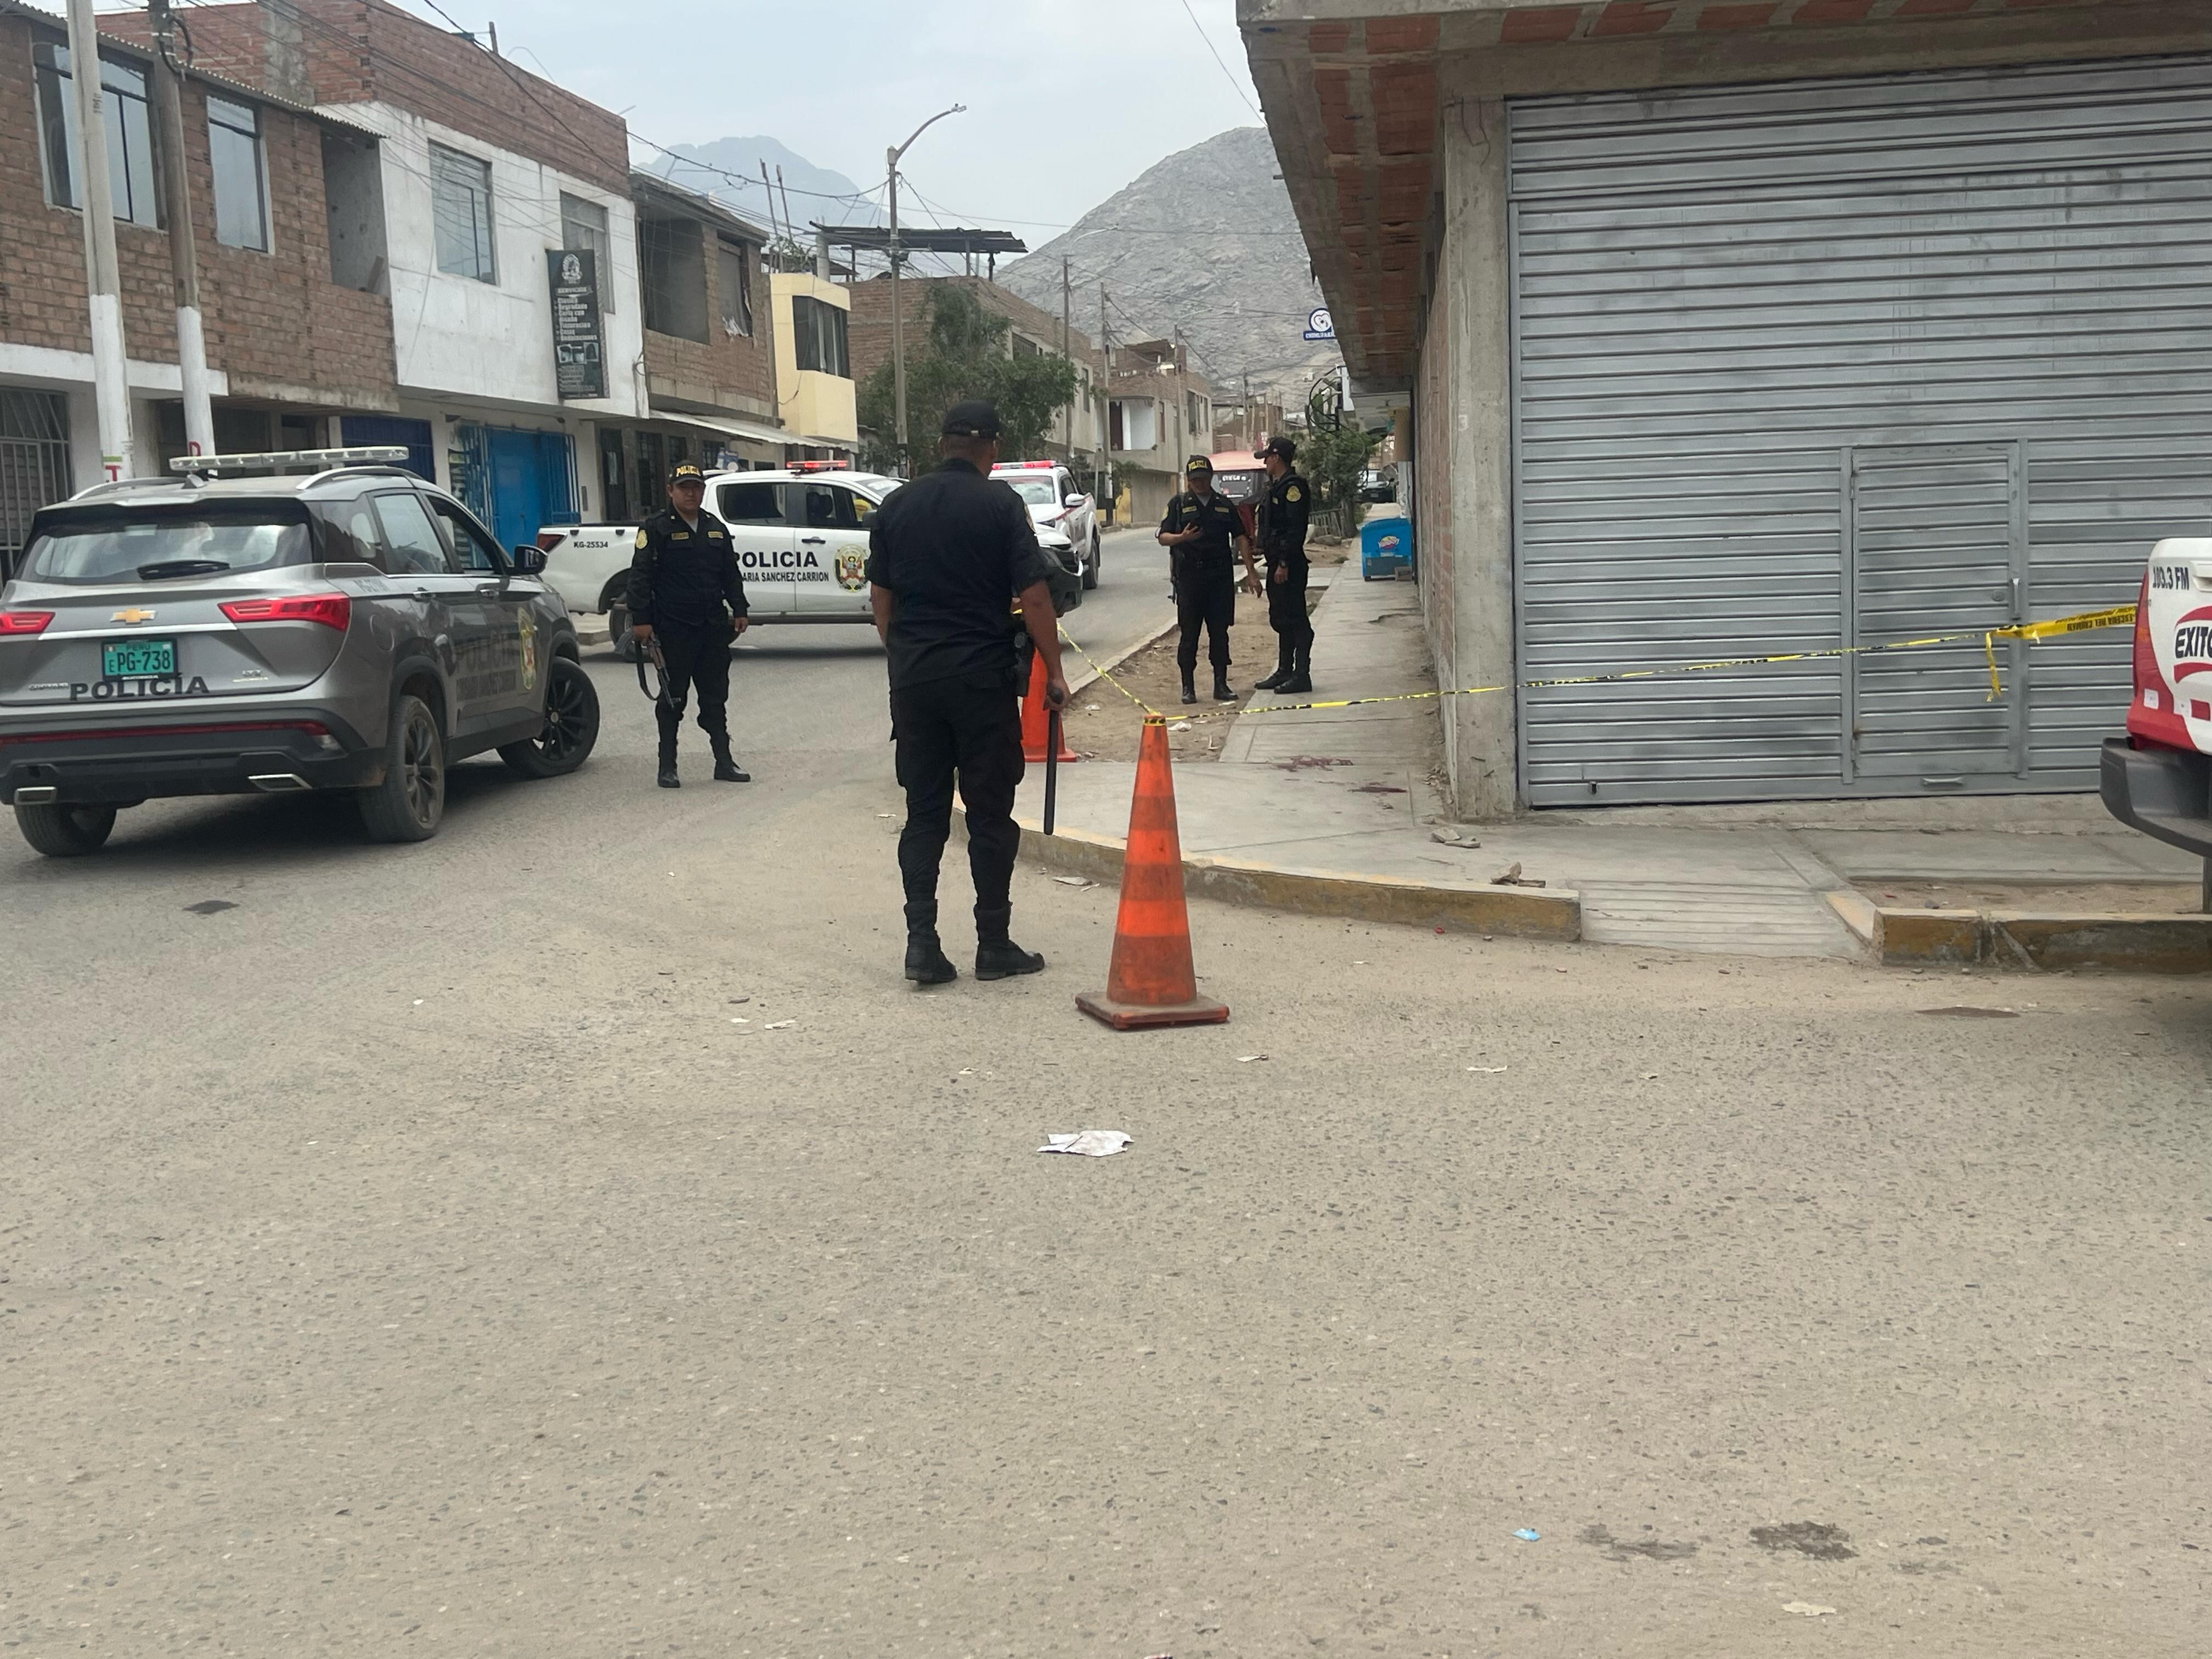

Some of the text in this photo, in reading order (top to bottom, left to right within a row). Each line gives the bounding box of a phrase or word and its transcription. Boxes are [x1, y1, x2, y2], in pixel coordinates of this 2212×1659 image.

[761, 572, 795, 582] SANCHEZ
[797, 572, 830, 582] CARRION
[2153, 566, 2190, 590] 103.3 FM
[117, 650, 171, 672] PG-738
